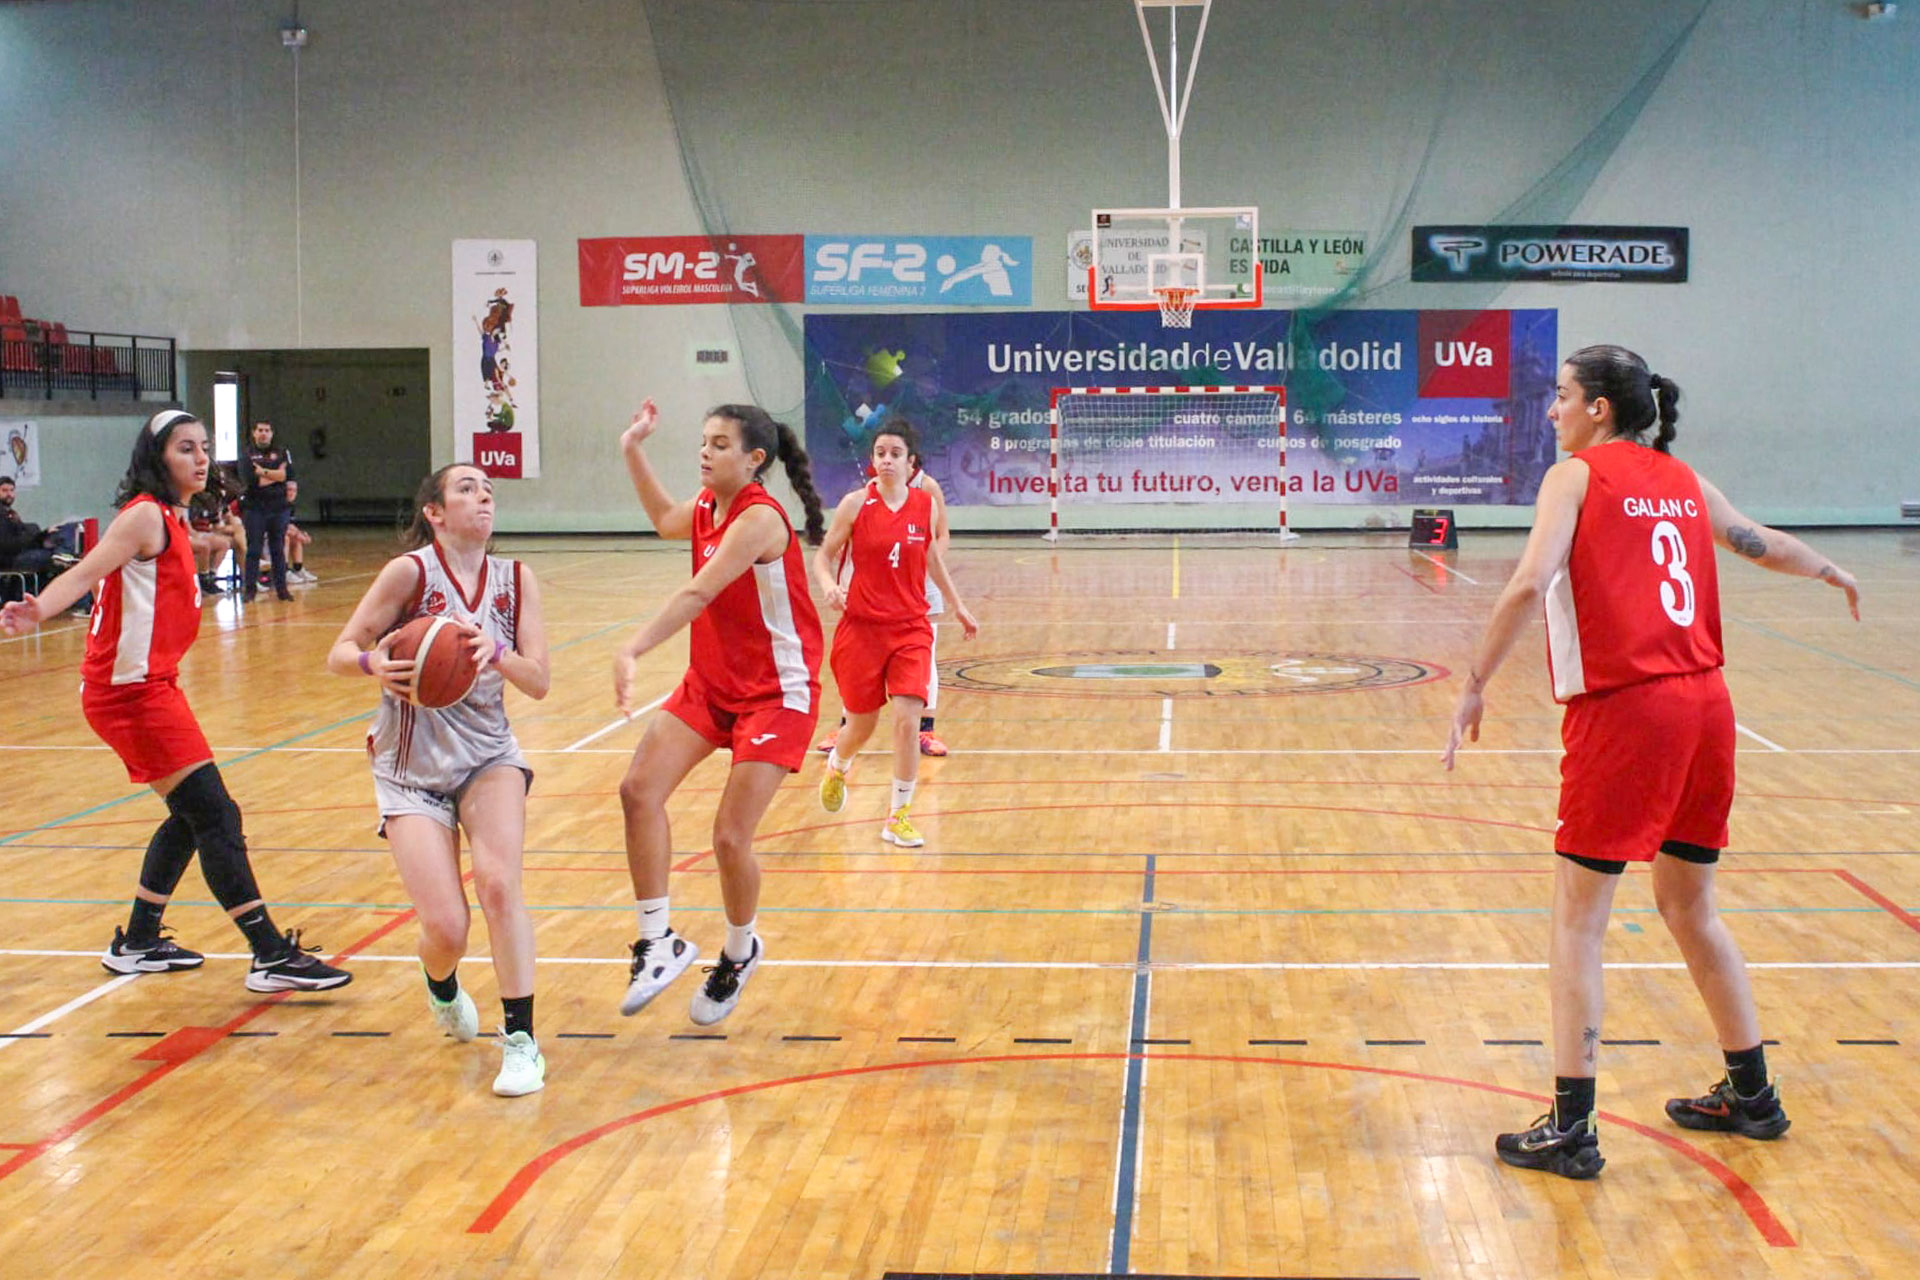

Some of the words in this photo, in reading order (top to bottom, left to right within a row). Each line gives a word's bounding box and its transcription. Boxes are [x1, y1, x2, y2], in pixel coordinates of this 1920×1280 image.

[1101, 237, 1169, 248] NIVERSIDAD
[1308, 240, 1318, 253] Y
[1323, 237, 1364, 254] LEÓN
[813, 243, 927, 282] SF-2
[1501, 243, 1665, 264] POWERADE
[623, 251, 720, 281] SM-2
[1102, 264, 1167, 275] VALLADOID
[1229, 260, 1248, 274] ES
[810, 285, 865, 296] SUPERLIGA
[1435, 341, 1493, 367] UVa
[957, 407, 982, 425] 54
[988, 408, 1051, 429] grados
[1173, 412, 1220, 425] cuatro
[1323, 409, 1402, 425] másteres
[990, 436, 1000, 449] 8
[1004, 438, 1079, 452] prograas
[1147, 434, 1215, 448] titulación
[1257, 437, 1306, 449] curos
[1333, 436, 1402, 451] posgrado
[480, 450, 516, 467] UVa
[1096, 472, 1122, 493] tu
[1131, 468, 1221, 496] futuro,
[1230, 475, 1279, 493] ven
[1288, 475, 1303, 493] a
[1313, 470, 1335, 493] la
[1345, 470, 1399, 493] UVa
[1623, 497, 1682, 518] GALAN
[1684, 499, 1698, 518] C
[1430, 518, 1449, 544] 3
[887, 541, 901, 569] 4
[1651, 520, 1696, 628] 3
